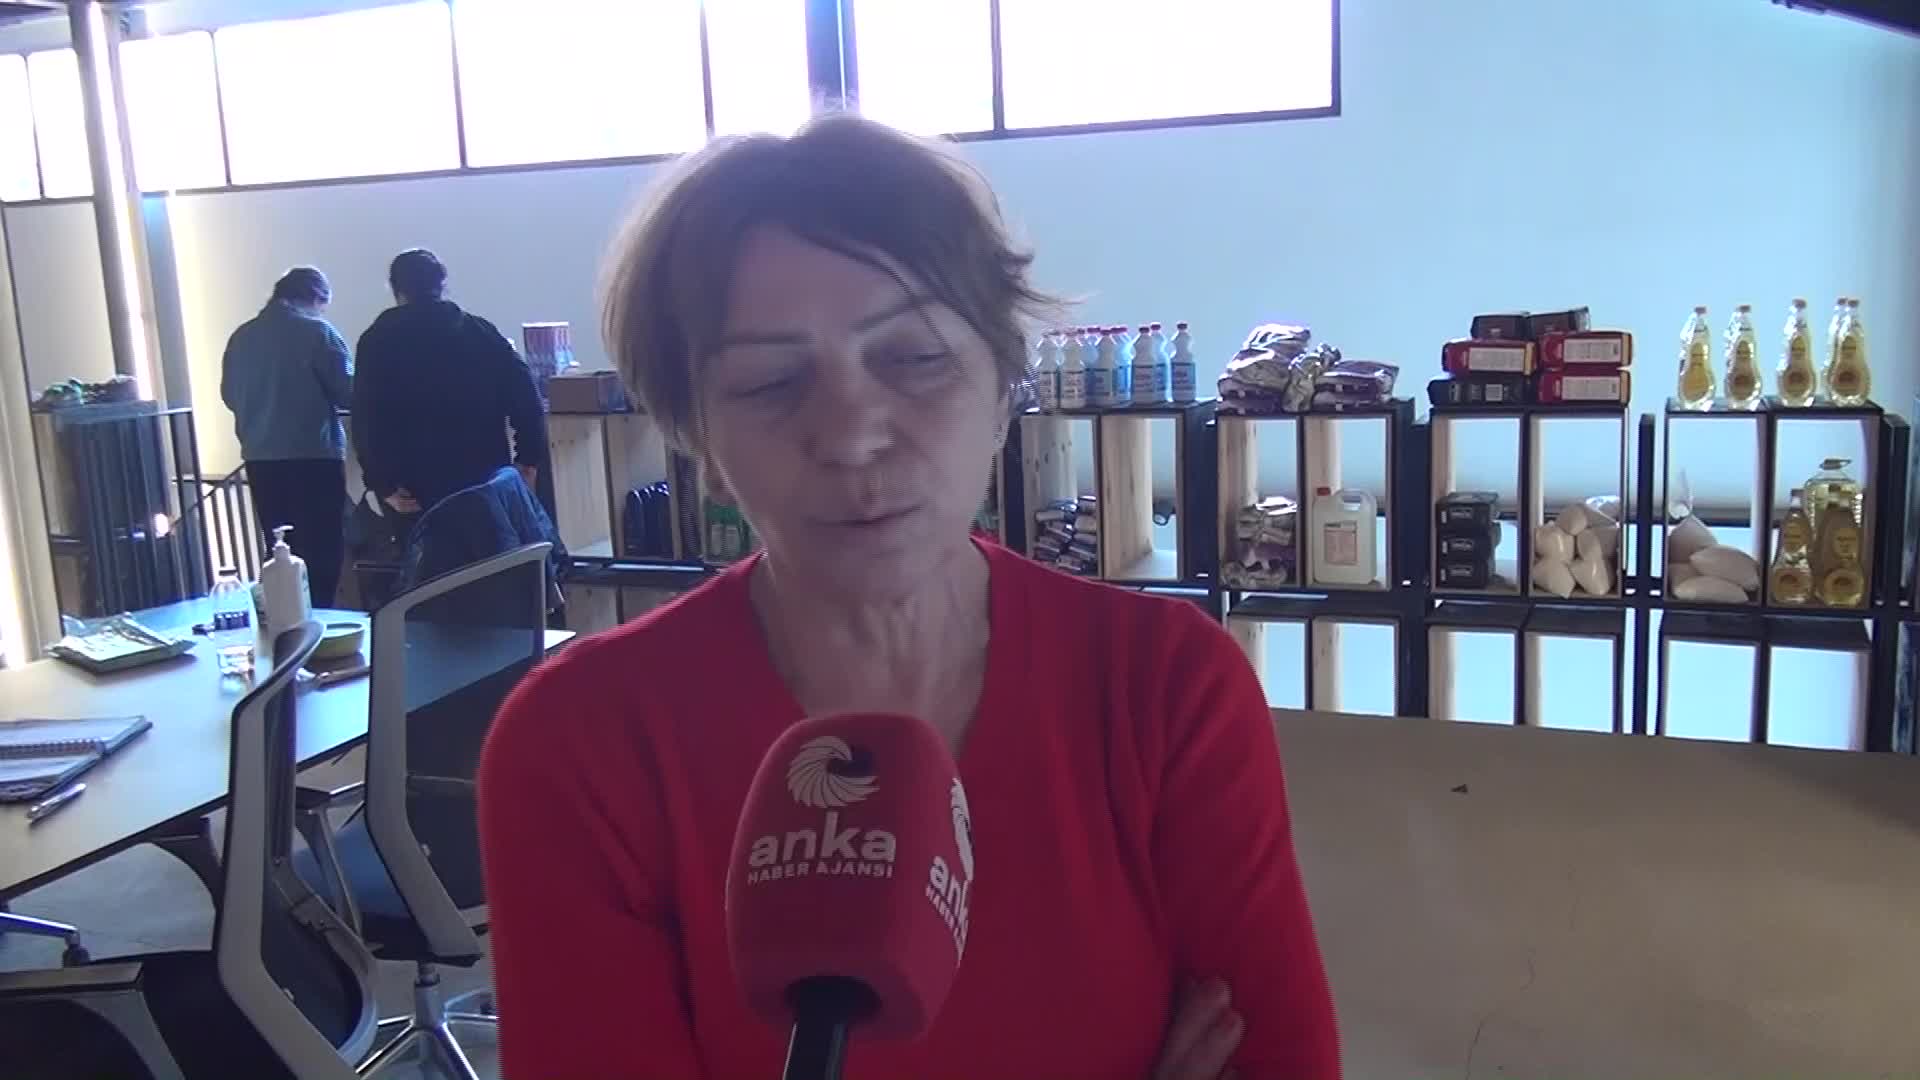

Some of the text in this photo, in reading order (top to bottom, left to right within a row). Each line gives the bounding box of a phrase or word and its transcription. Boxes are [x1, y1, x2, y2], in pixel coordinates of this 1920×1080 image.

[748, 811, 897, 867] anka
[747, 861, 893, 886] HABER AJANSI
